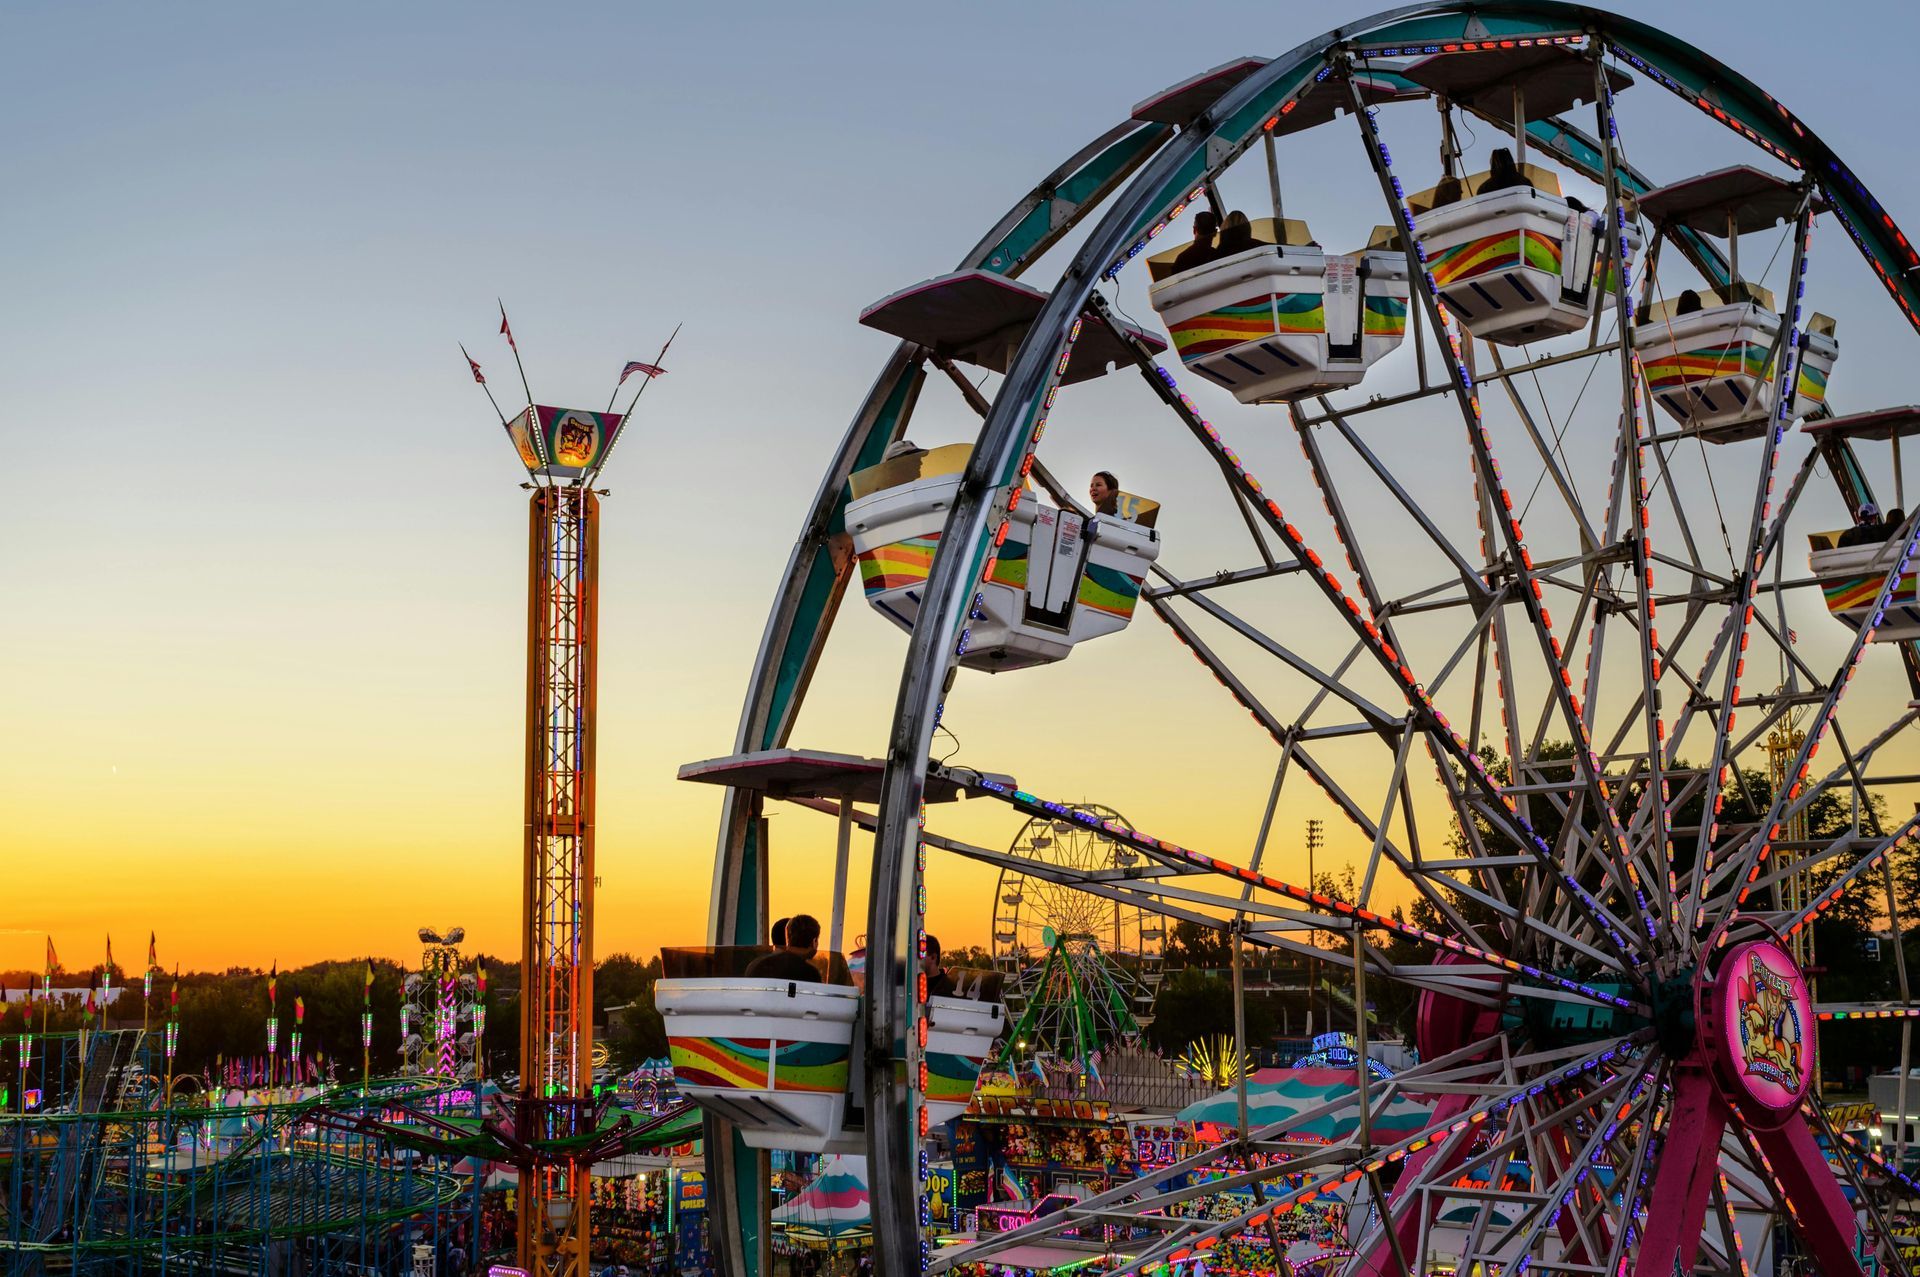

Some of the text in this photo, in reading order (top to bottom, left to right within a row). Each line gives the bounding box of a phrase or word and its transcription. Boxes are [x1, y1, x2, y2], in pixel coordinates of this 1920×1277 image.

[952, 970, 983, 1001] 14
[1751, 955, 1793, 998] BUTLER
[1312, 1031, 1358, 1052] STARSHI
[1327, 1048, 1348, 1060] 3000
[1034, 1099, 1111, 1121] SHOT
